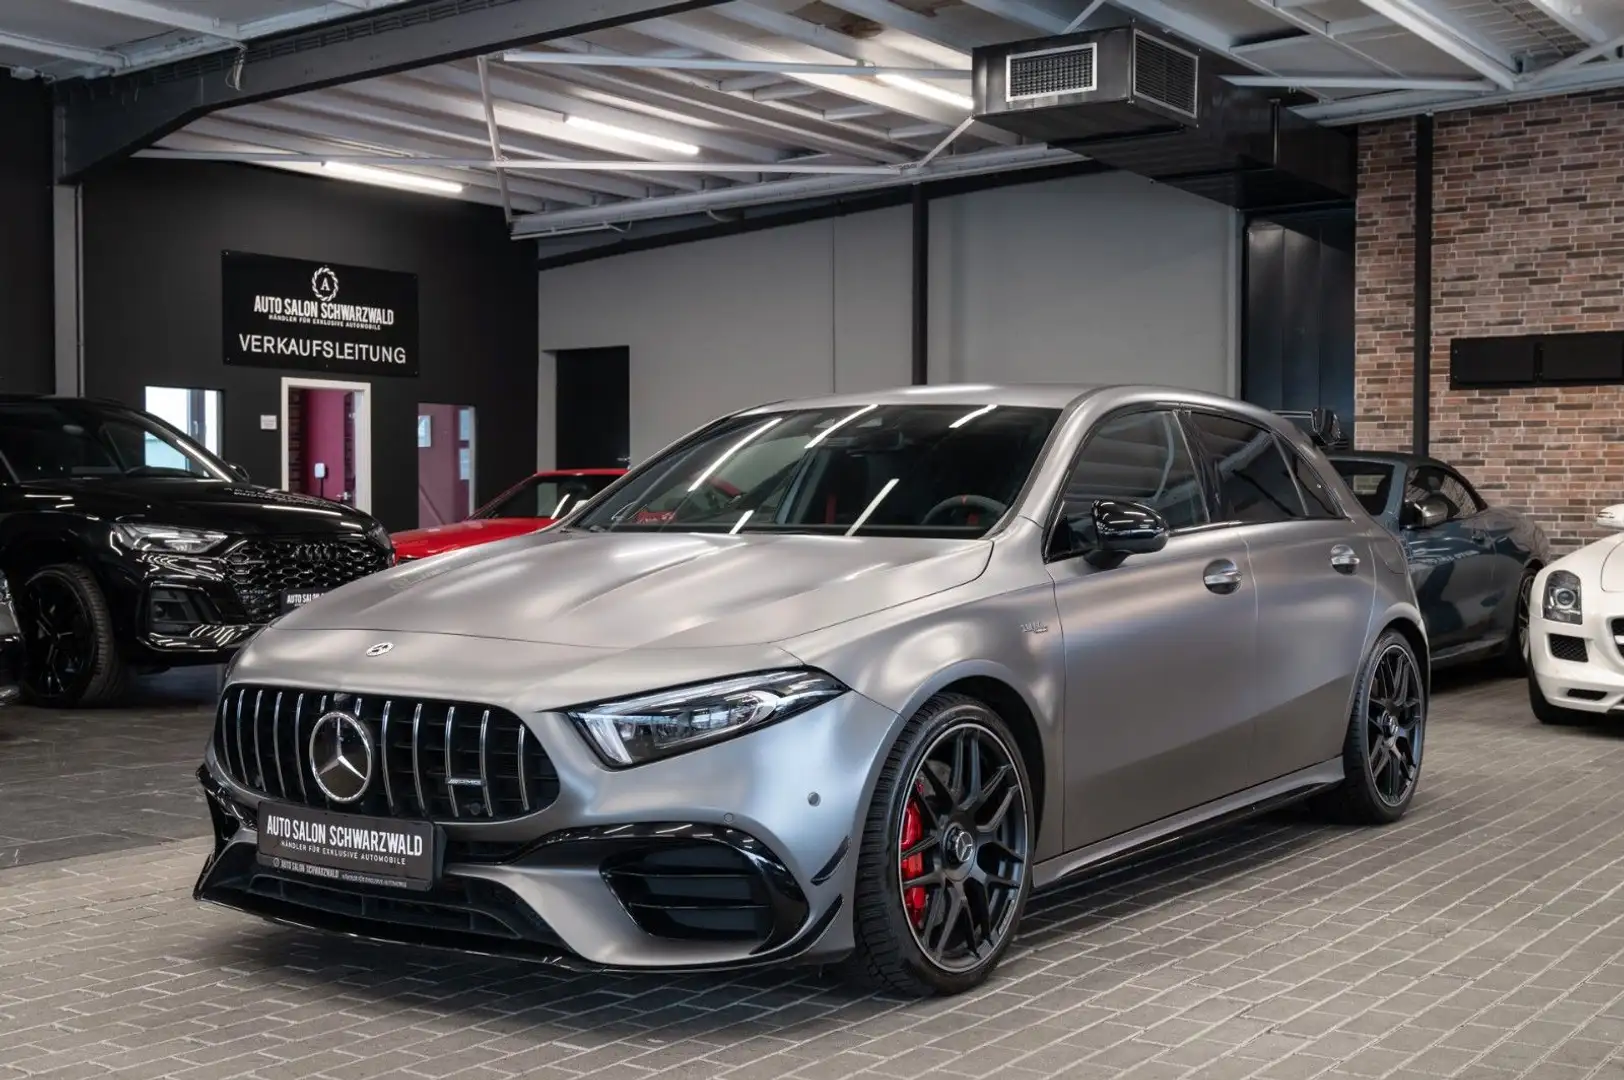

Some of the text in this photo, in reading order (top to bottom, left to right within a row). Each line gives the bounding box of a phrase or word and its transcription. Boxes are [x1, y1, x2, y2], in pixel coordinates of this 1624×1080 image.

[320, 277, 331, 291] A
[253, 295, 394, 325] AUTO SALON SCHWARZWALD
[345, 322, 381, 331] AUTOMOBILE
[238, 333, 407, 364] VERKAUFSLEITUNG
[286, 594, 302, 604] AUTO
[266, 814, 423, 857] AUTO SALON SCHWARZWALD
[280, 839, 407, 866] HÄNDLER FÜR EXKLUSIVE AUTOMOBILE
